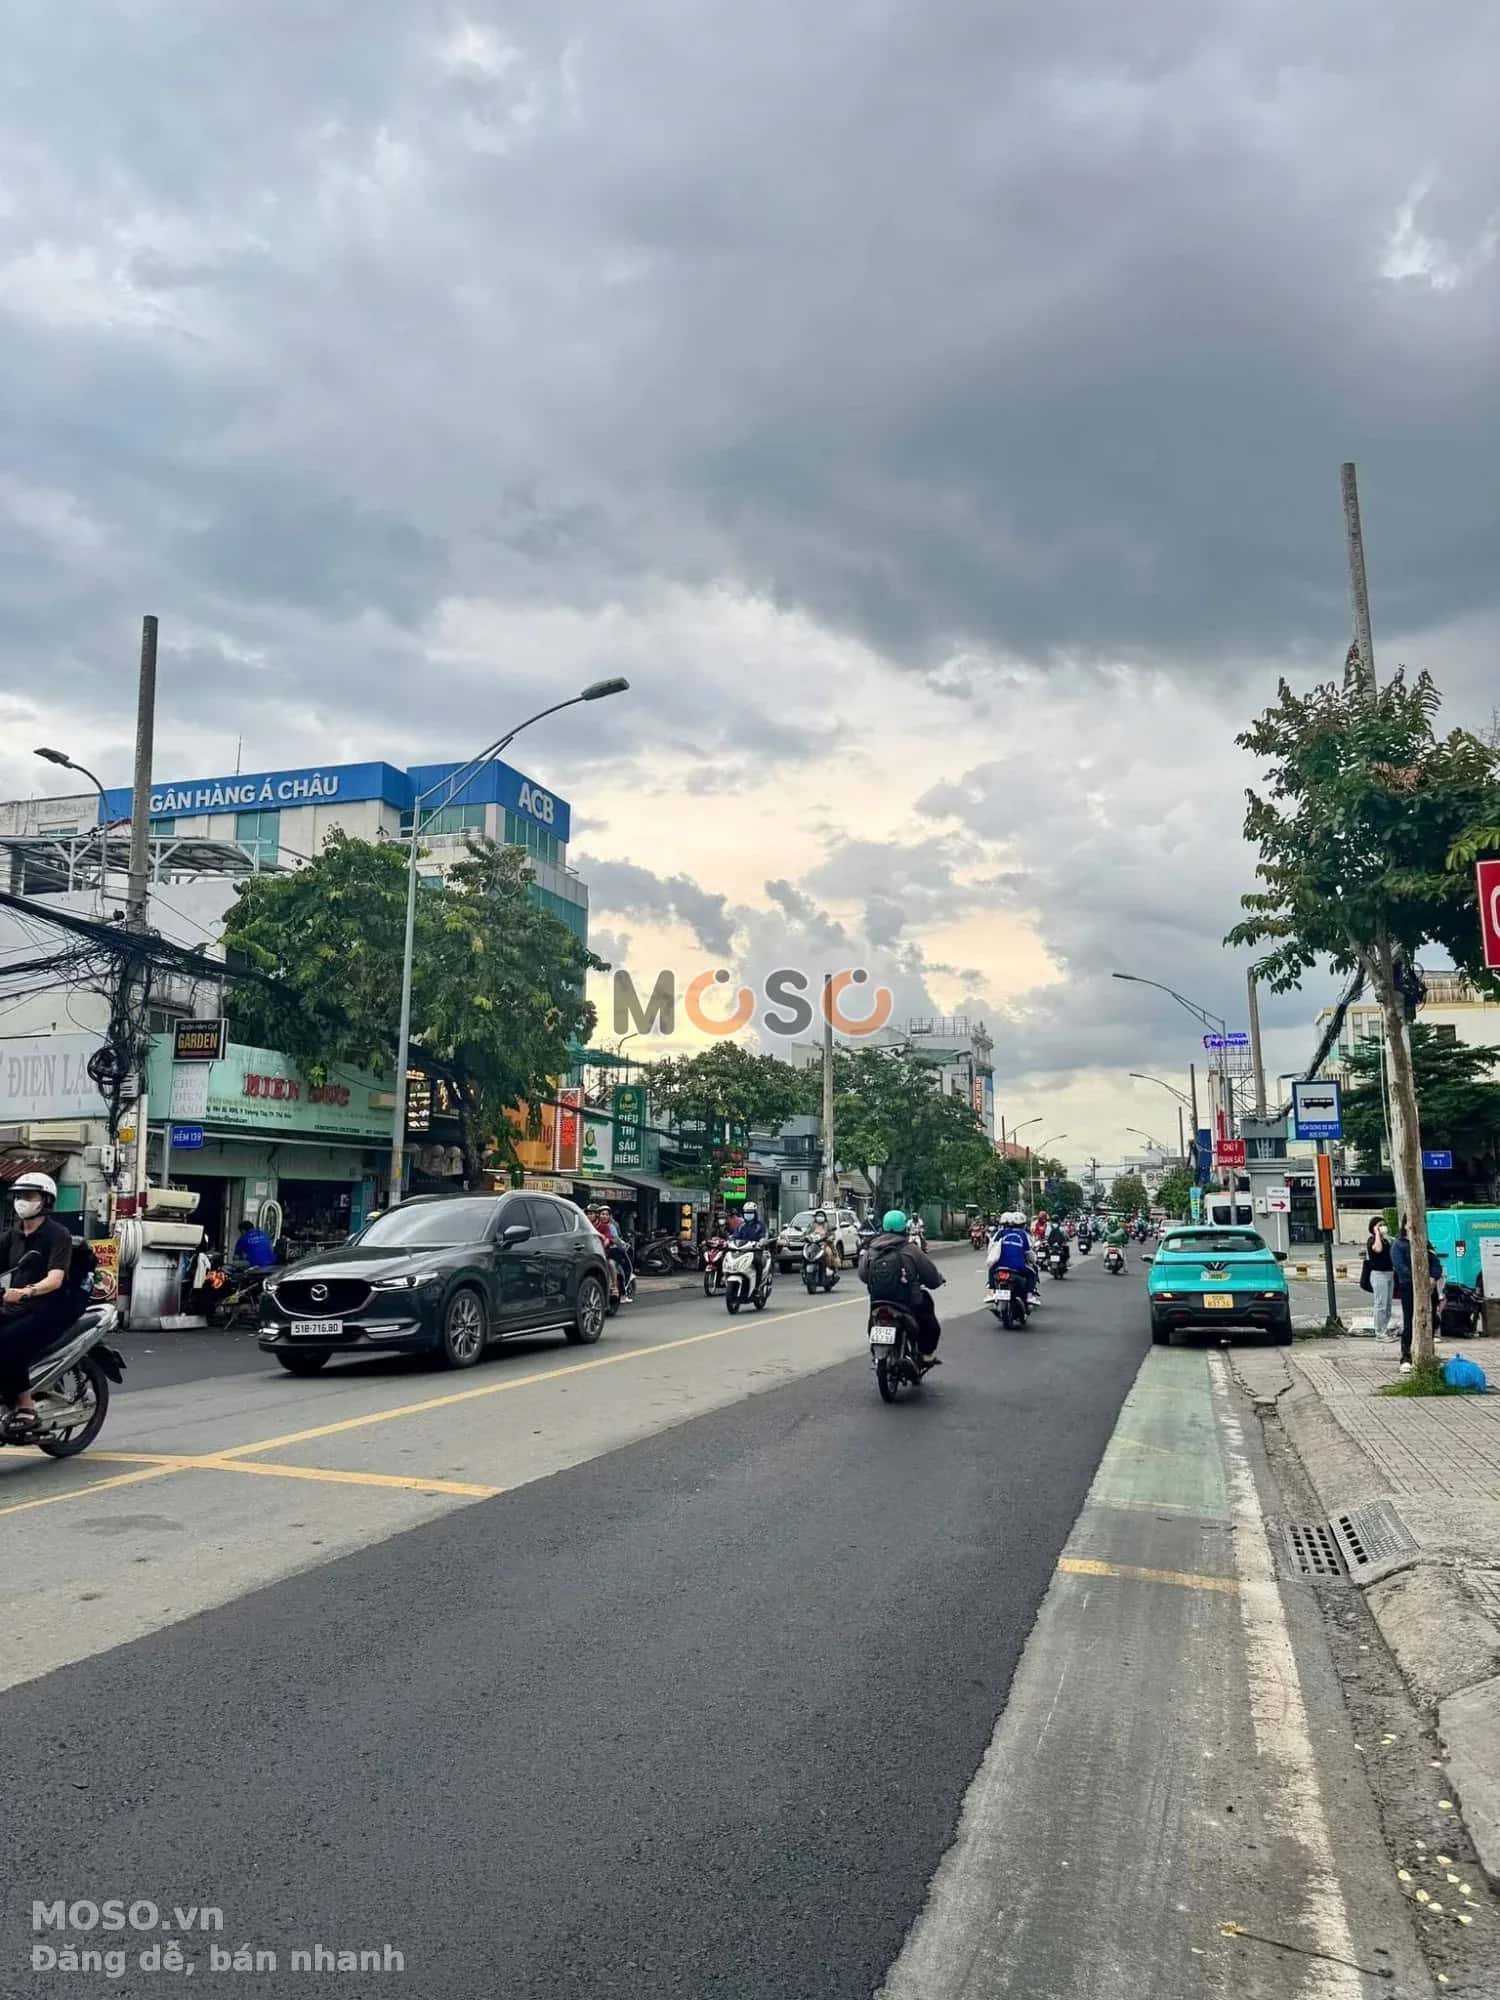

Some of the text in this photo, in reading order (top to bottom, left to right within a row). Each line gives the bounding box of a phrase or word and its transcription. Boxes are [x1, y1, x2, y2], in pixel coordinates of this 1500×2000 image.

[150, 773, 340, 813] GÂN HÀNG Á CHÂU
[518, 781, 554, 825] ACB
[178, 1032, 218, 1049] GARDEN
[8, 1041, 56, 1112] ĐIỆN
[621, 1126, 635, 1138] THỊ
[614, 1151, 640, 1164] RIÊNG
